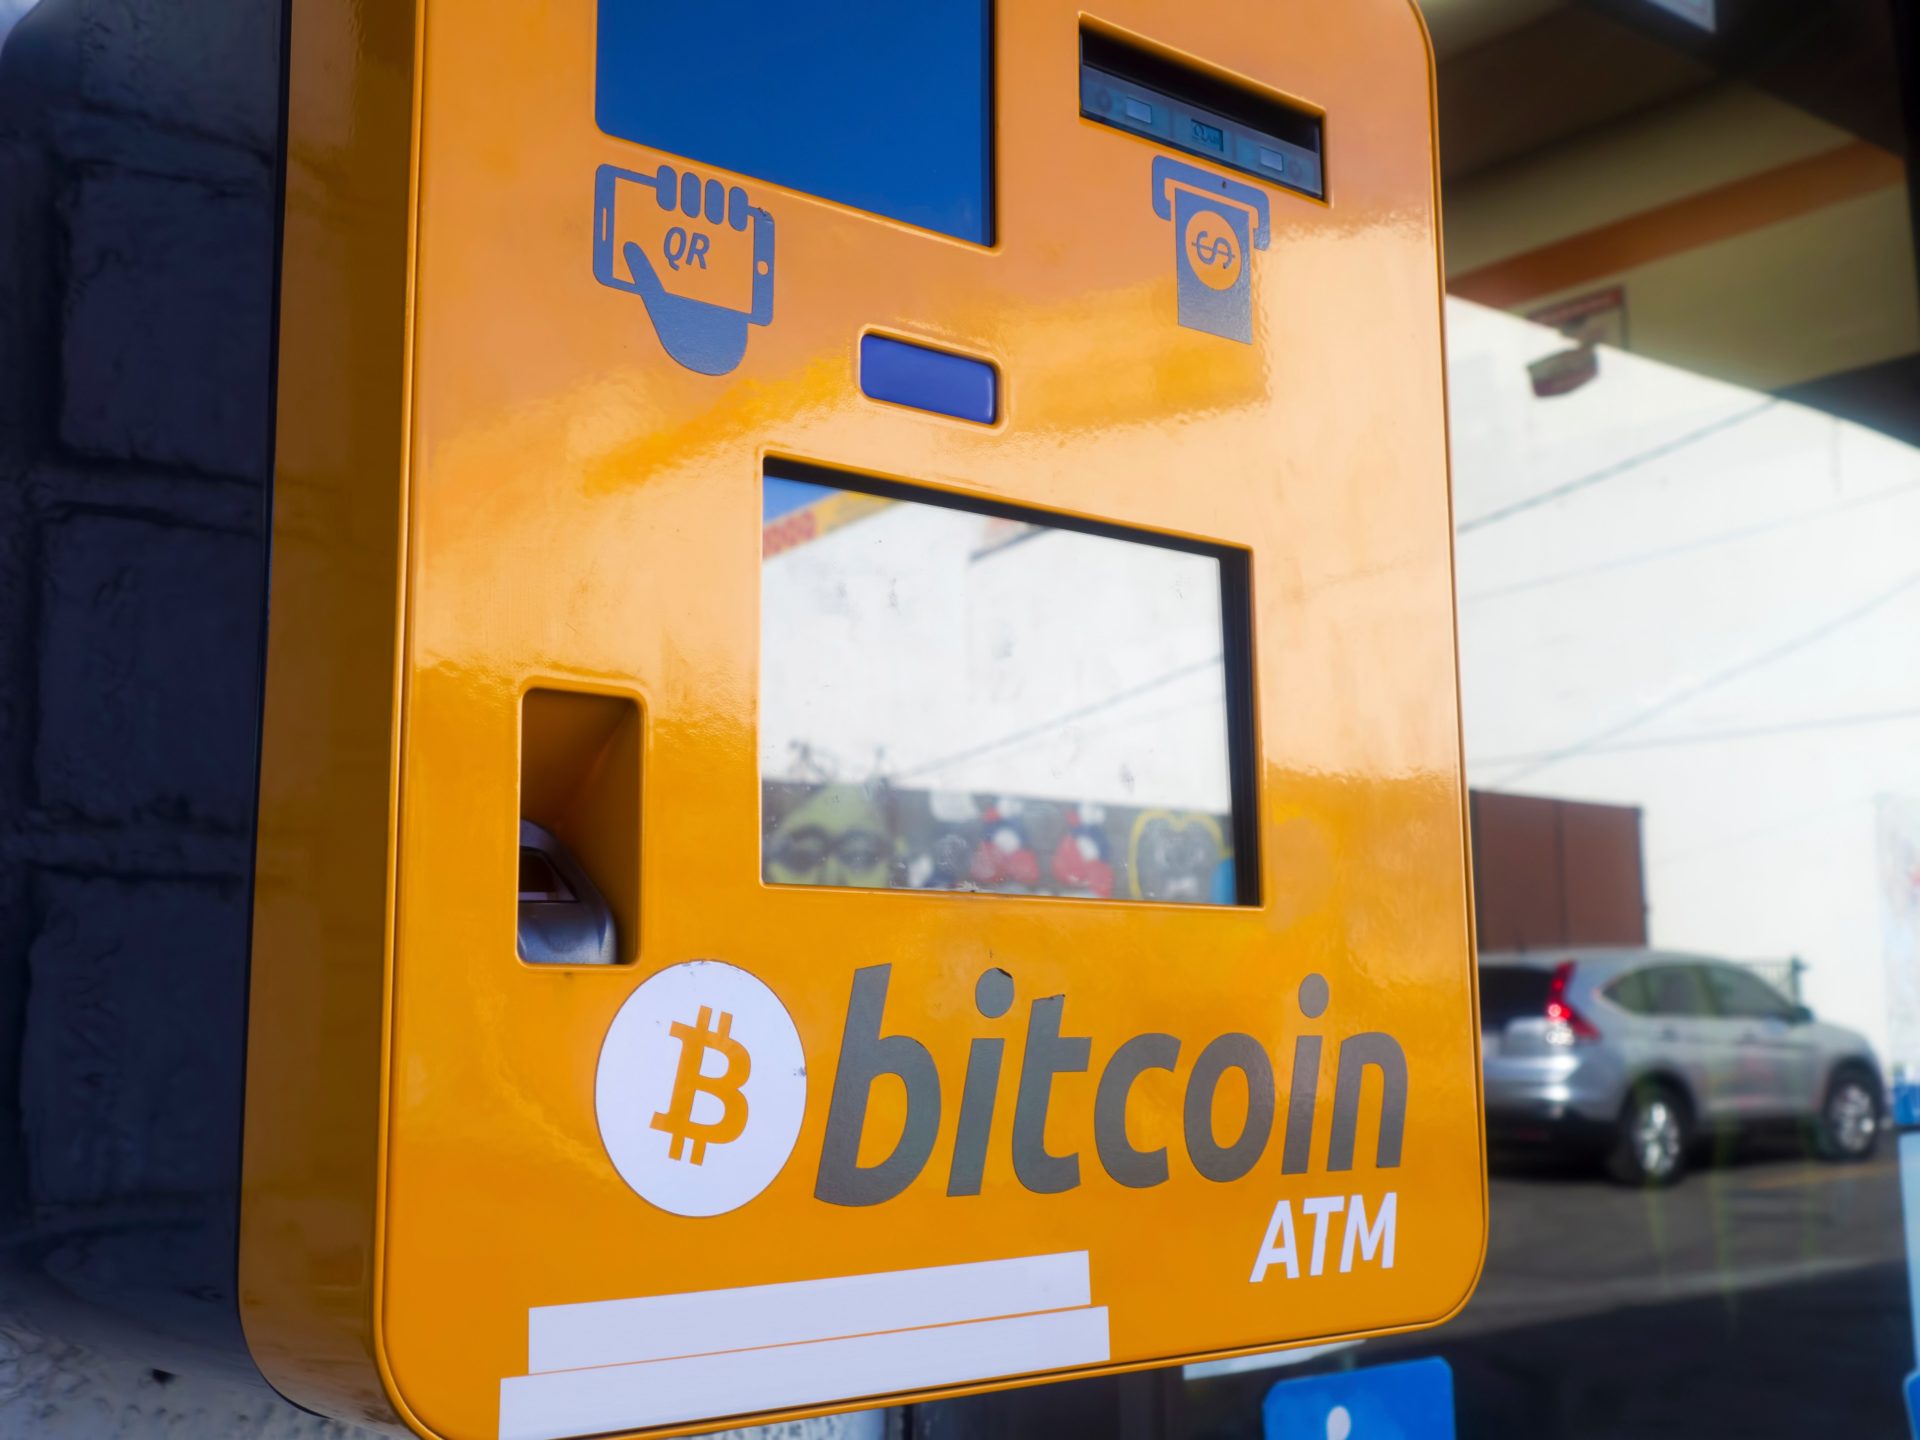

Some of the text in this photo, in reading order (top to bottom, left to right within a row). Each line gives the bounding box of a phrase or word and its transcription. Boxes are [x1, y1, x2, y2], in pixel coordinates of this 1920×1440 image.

[663, 226, 710, 271] QR
[813, 962, 1408, 1207] bitcoin
[1249, 1192, 1398, 1283] ATM
